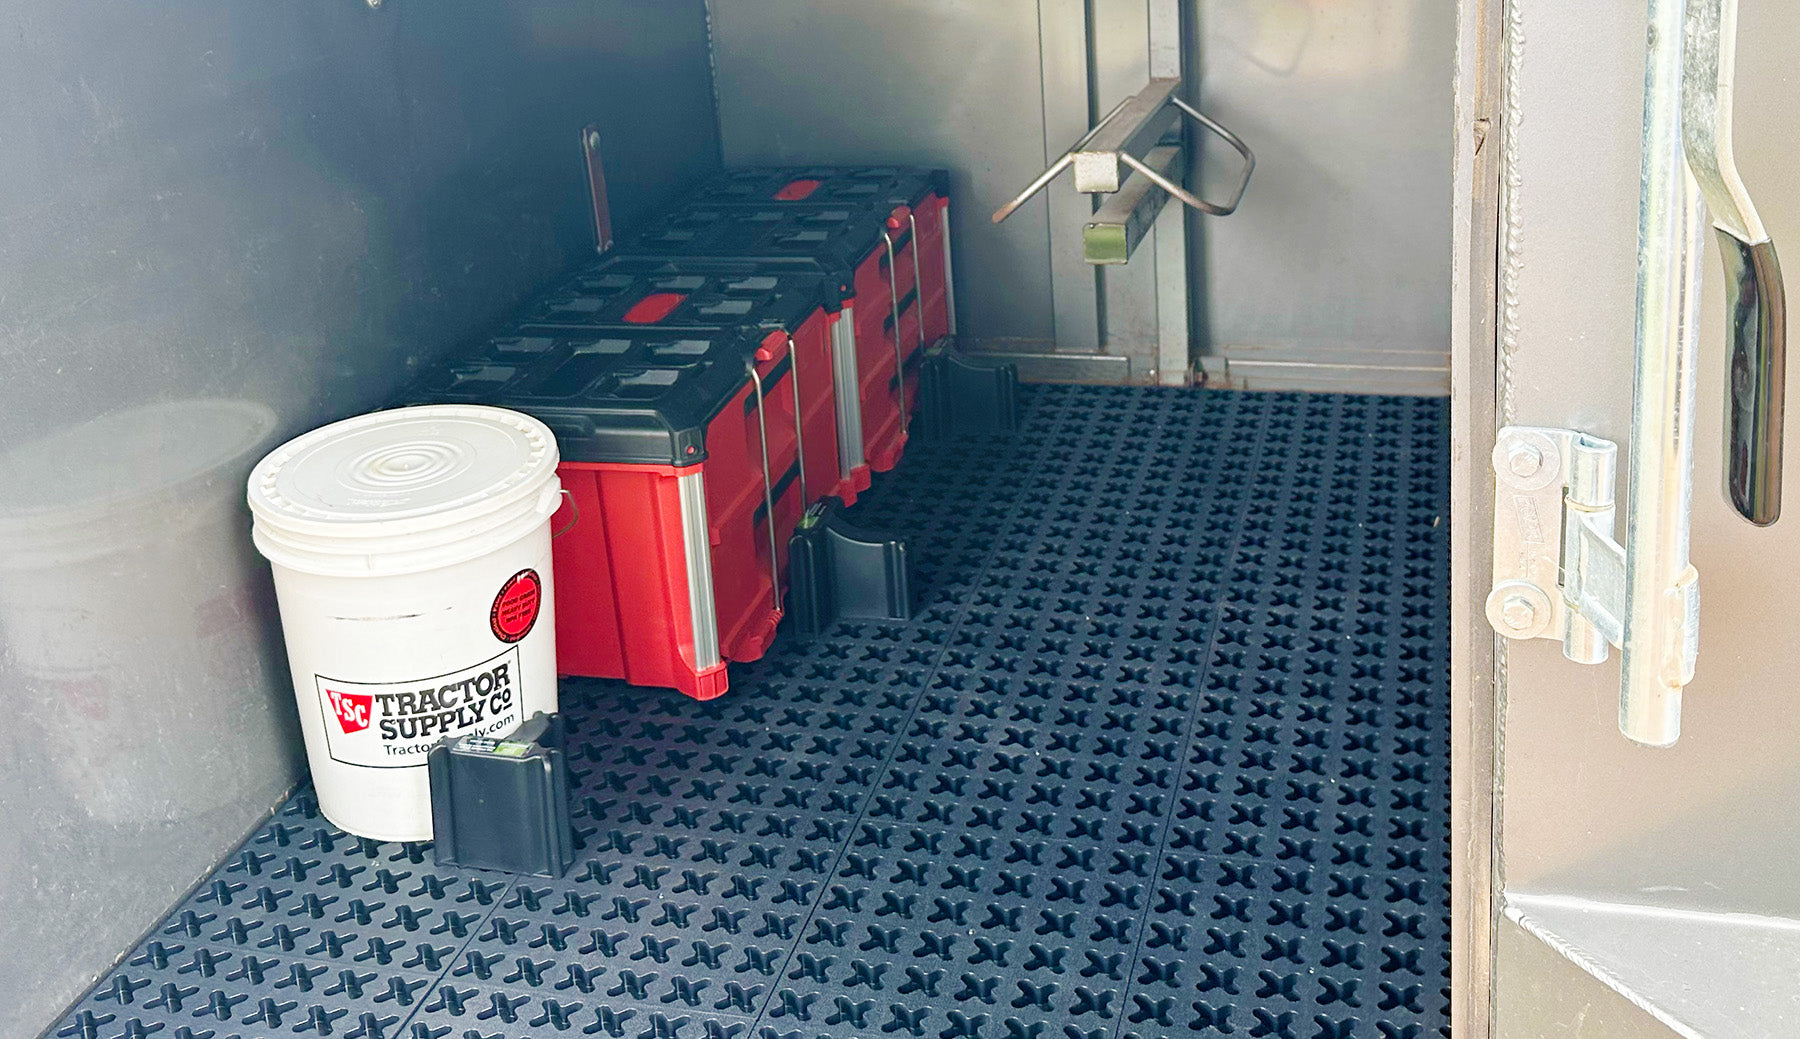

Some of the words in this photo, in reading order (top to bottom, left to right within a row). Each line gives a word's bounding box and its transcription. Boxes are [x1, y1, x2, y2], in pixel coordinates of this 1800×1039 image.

[330, 691, 369, 727] TSC
[375, 663, 510, 716] TRACTOR
[380, 699, 486, 740] SUPPLY
